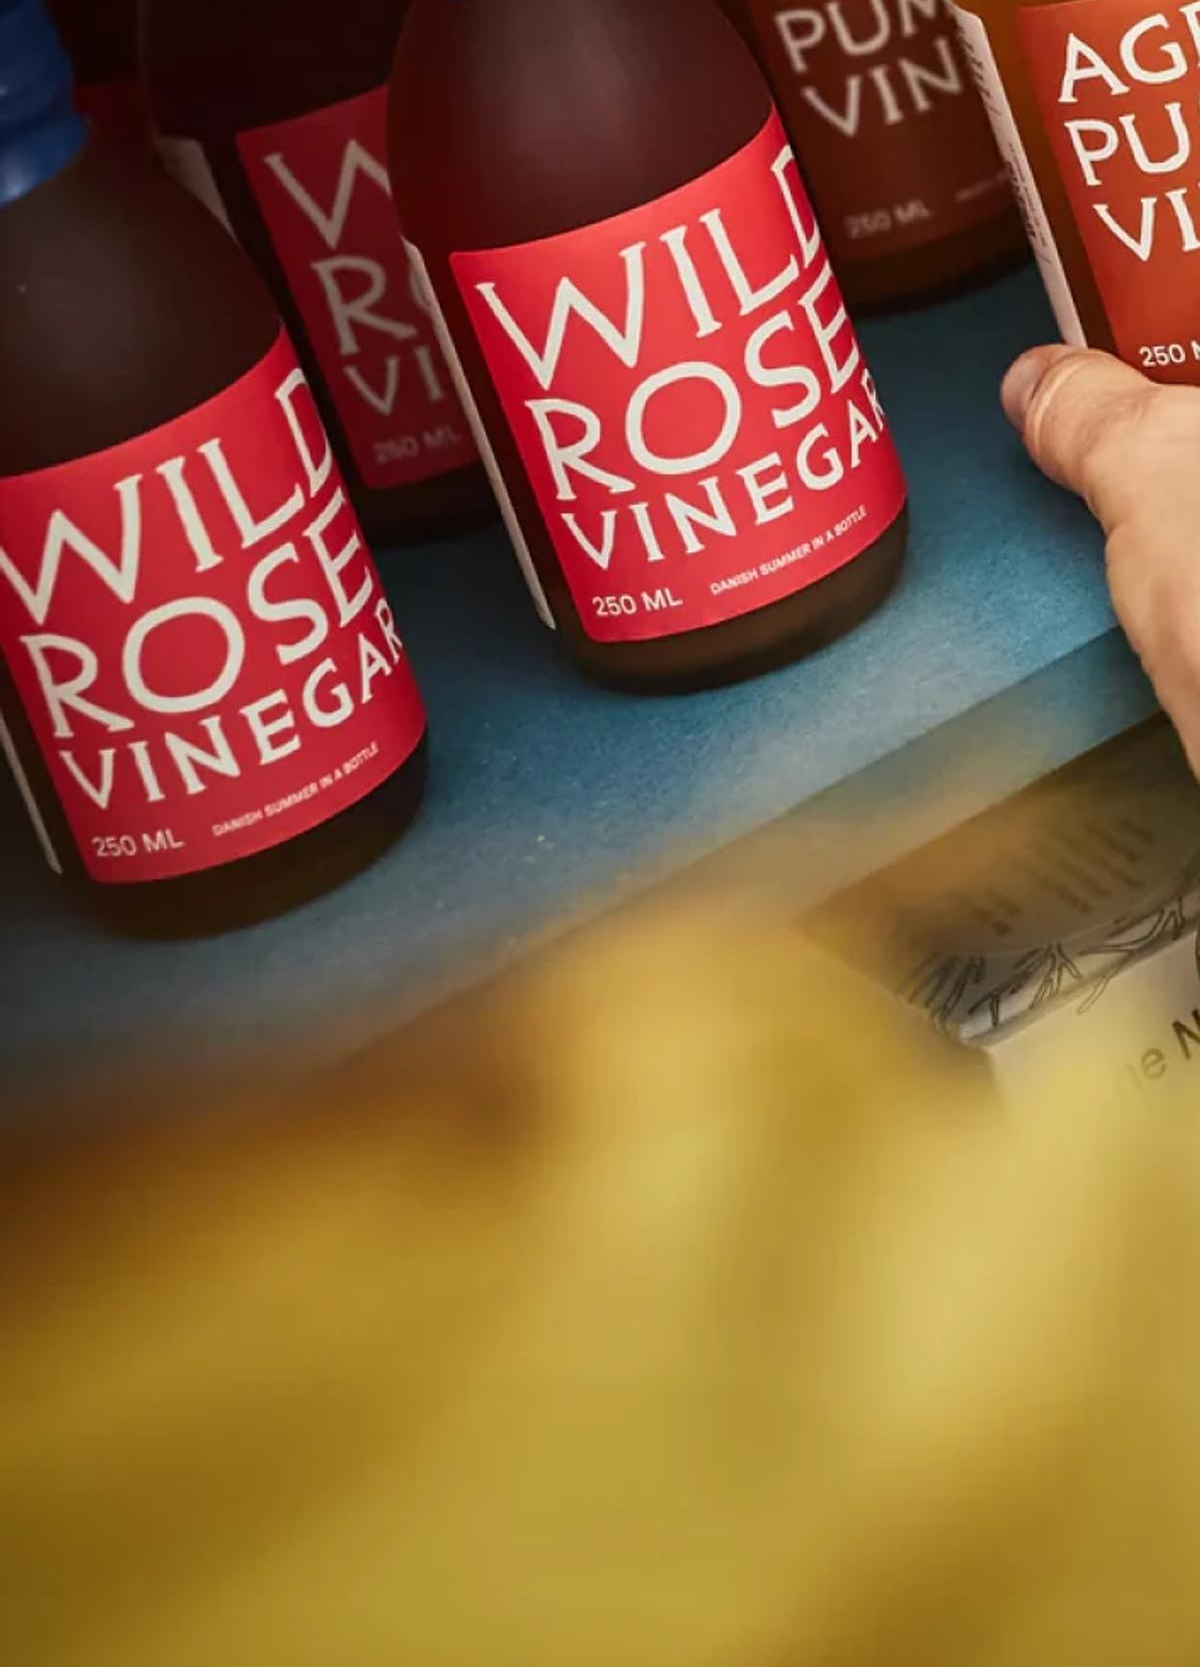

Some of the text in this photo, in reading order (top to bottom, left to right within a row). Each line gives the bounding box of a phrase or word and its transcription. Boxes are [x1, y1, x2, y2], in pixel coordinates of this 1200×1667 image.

[475, 144, 822, 391] WILD
[1140, 342, 1186, 367] 250
[525, 259, 860, 501] ROSE
[561, 368, 885, 570] VINEGAR
[0, 367, 334, 626] WILD
[709, 504, 868, 596] DANISH SUMMER IN A BOTTLE
[20, 486, 373, 739] ROSE
[593, 586, 684, 618] 250 ML
[60, 597, 403, 810] VINEGAR
[211, 740, 379, 837] DANISH SUMMER IN A BOTTLE
[92, 828, 184, 858] 250 ML
